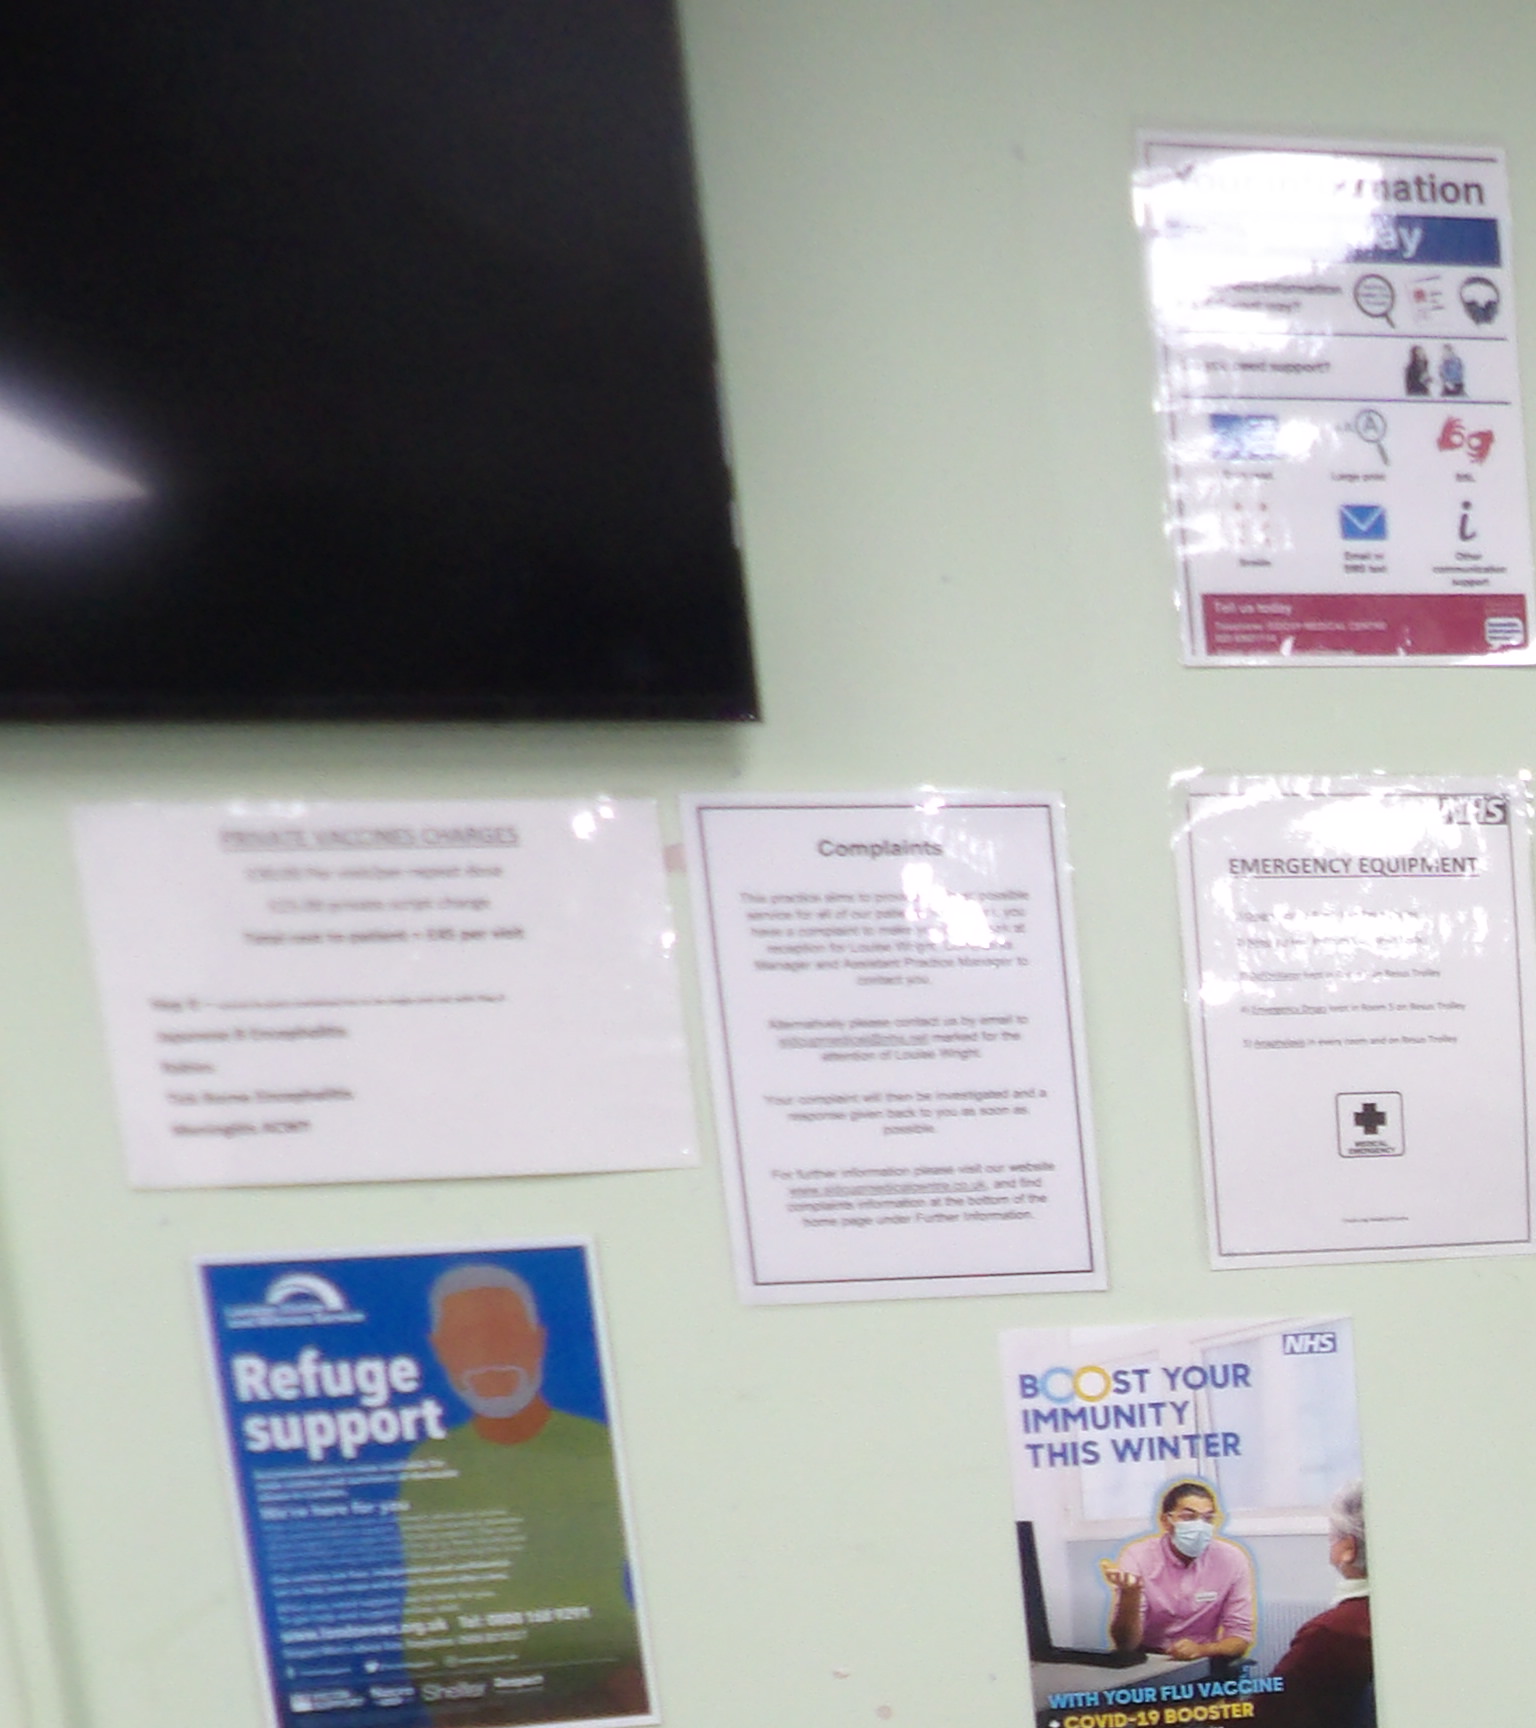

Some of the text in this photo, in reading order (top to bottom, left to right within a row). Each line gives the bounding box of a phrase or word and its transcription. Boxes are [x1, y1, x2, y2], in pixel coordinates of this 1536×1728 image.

[818, 839, 943, 859] Complaints
[1229, 857, 1478, 876] EMERGENCY EQUIPMENT
[1283, 1332, 1336, 1355] NHS
[232, 1347, 419, 1407] Refuge
[1019, 1363, 1251, 1403] BOOST YOUR
[243, 1398, 447, 1461] support
[1022, 1400, 1189, 1434] IMMUNITY
[1026, 1432, 1242, 1468] THIS WINTER
[1049, 1677, 1284, 1709] WITH YOUR FLU VACCINE
[1164, 1702, 1254, 1724] BOOSTER
